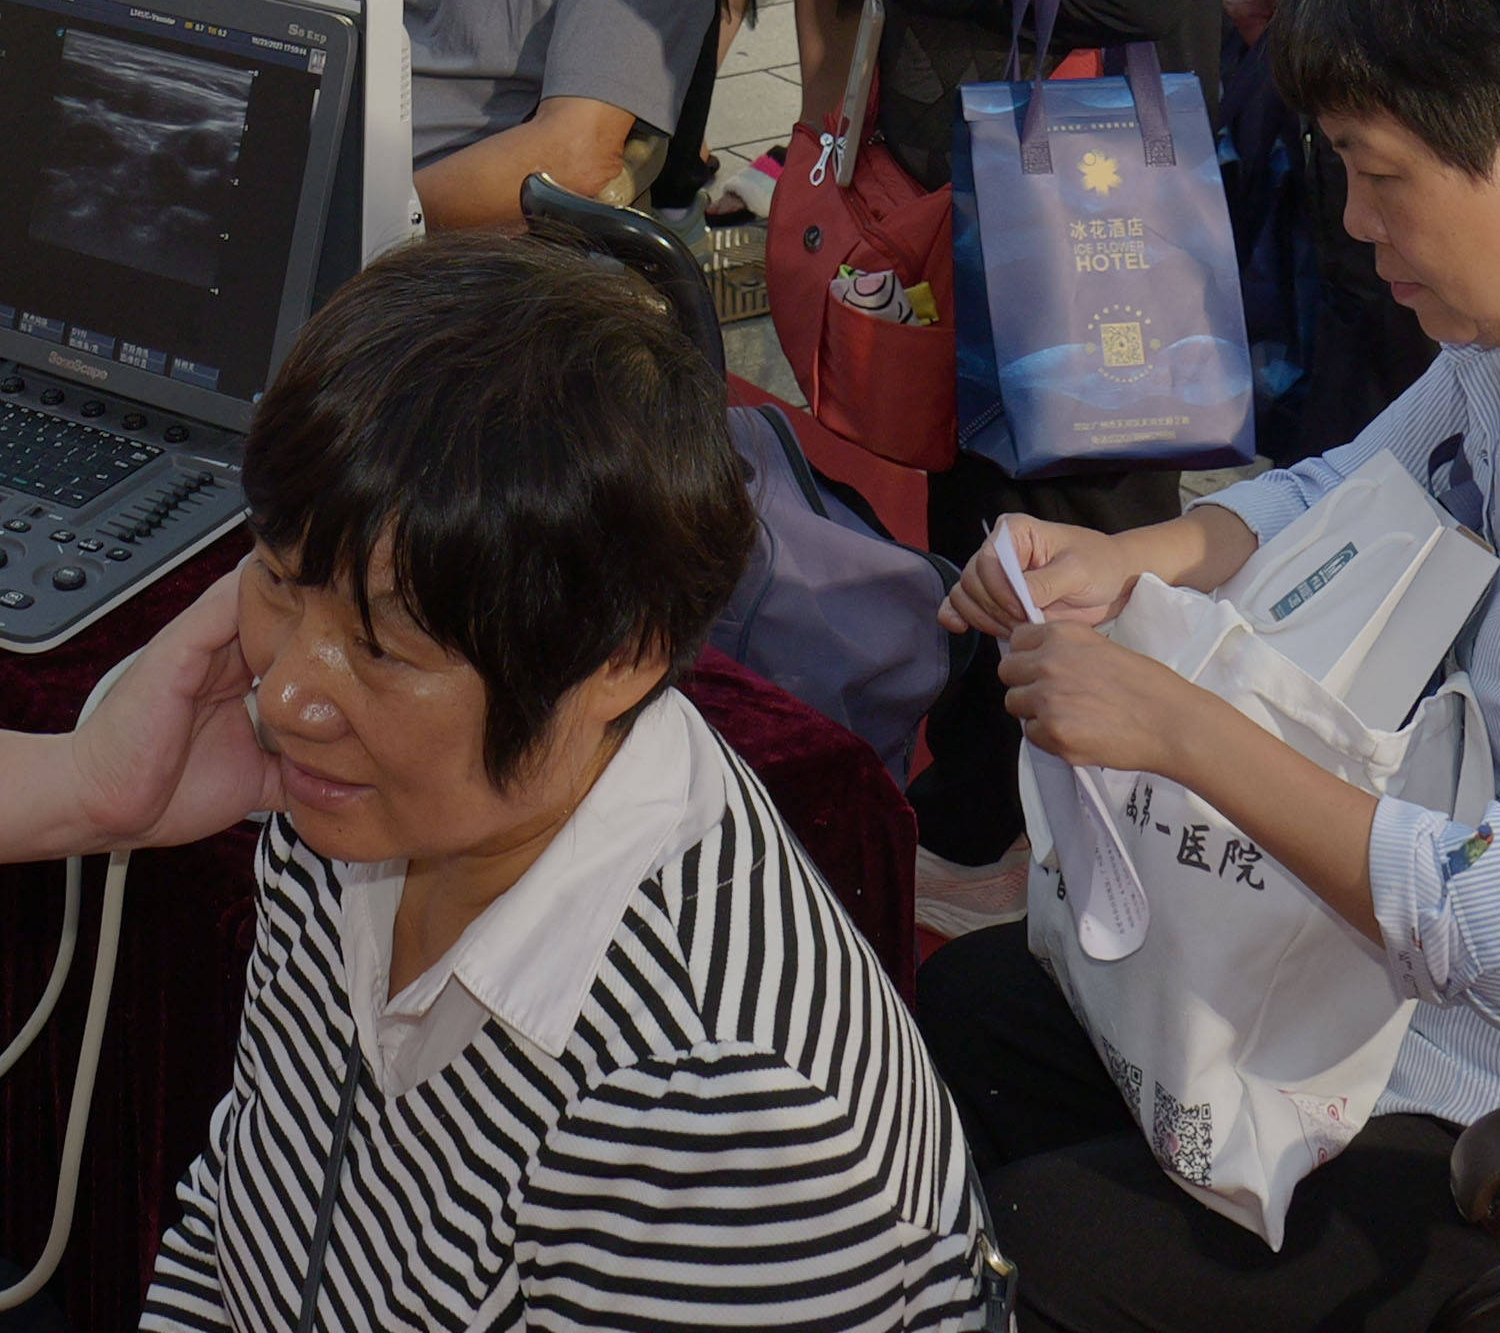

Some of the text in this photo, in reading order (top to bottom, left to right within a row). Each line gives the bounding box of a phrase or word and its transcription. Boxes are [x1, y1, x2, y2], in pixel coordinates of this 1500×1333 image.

[1069, 218, 1144, 240] 冰花酒店
[1073, 240, 1145, 255] ICE FLOWER
[1075, 252, 1150, 273] HOTEL
[47, 349, 109, 381] SonoScape
